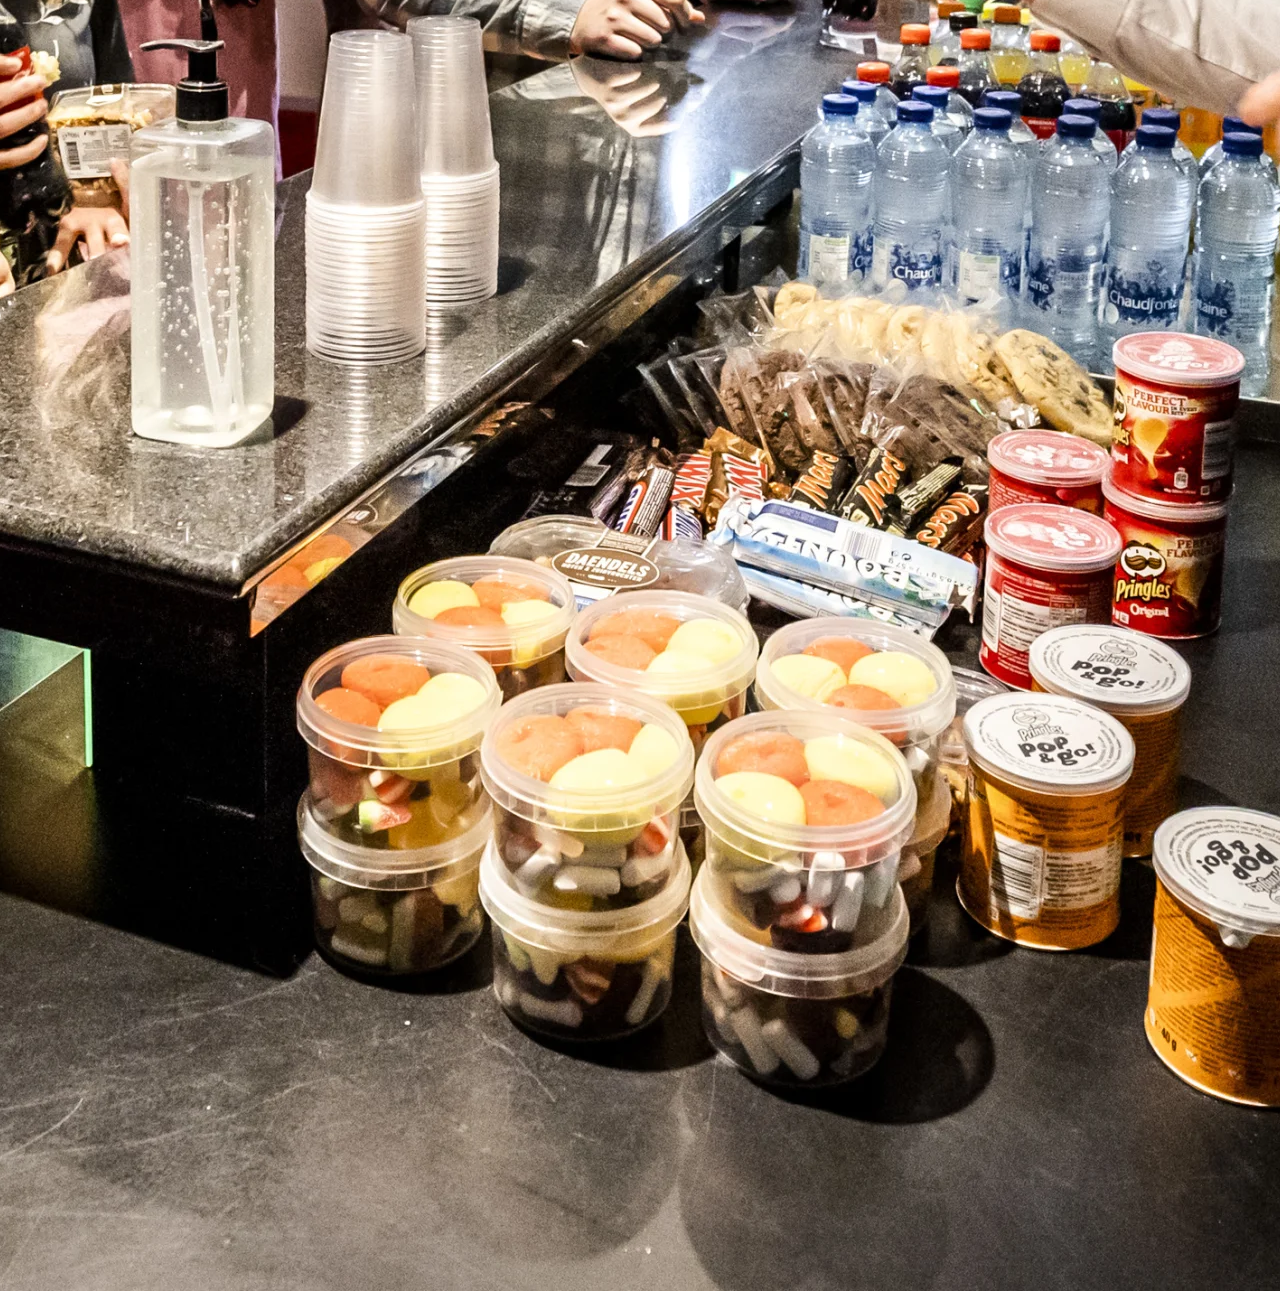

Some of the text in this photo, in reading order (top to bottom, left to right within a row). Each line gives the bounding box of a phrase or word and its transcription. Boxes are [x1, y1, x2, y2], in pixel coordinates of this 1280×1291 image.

[1126, 396, 1170, 415] FLAVOUR
[1133, 388, 1188, 406] PERFECT
[669, 453, 712, 508] TWIX
[722, 452, 768, 504] TWI
[794, 449, 840, 509] Mars
[855, 448, 906, 526] Mars
[916, 491, 980, 548] Mars
[564, 552, 651, 578] DAENDELS
[751, 527, 910, 590] BOUNTY
[1116, 578, 1171, 602] Pringles
[1129, 603, 1170, 619] Original
[1088, 652, 1138, 668] Pringles
[1080, 671, 1146, 689] & go!
[1018, 722, 1065, 741] Pringles
[1038, 743, 1097, 766] & go!
[1196, 839, 1250, 875] & go!
